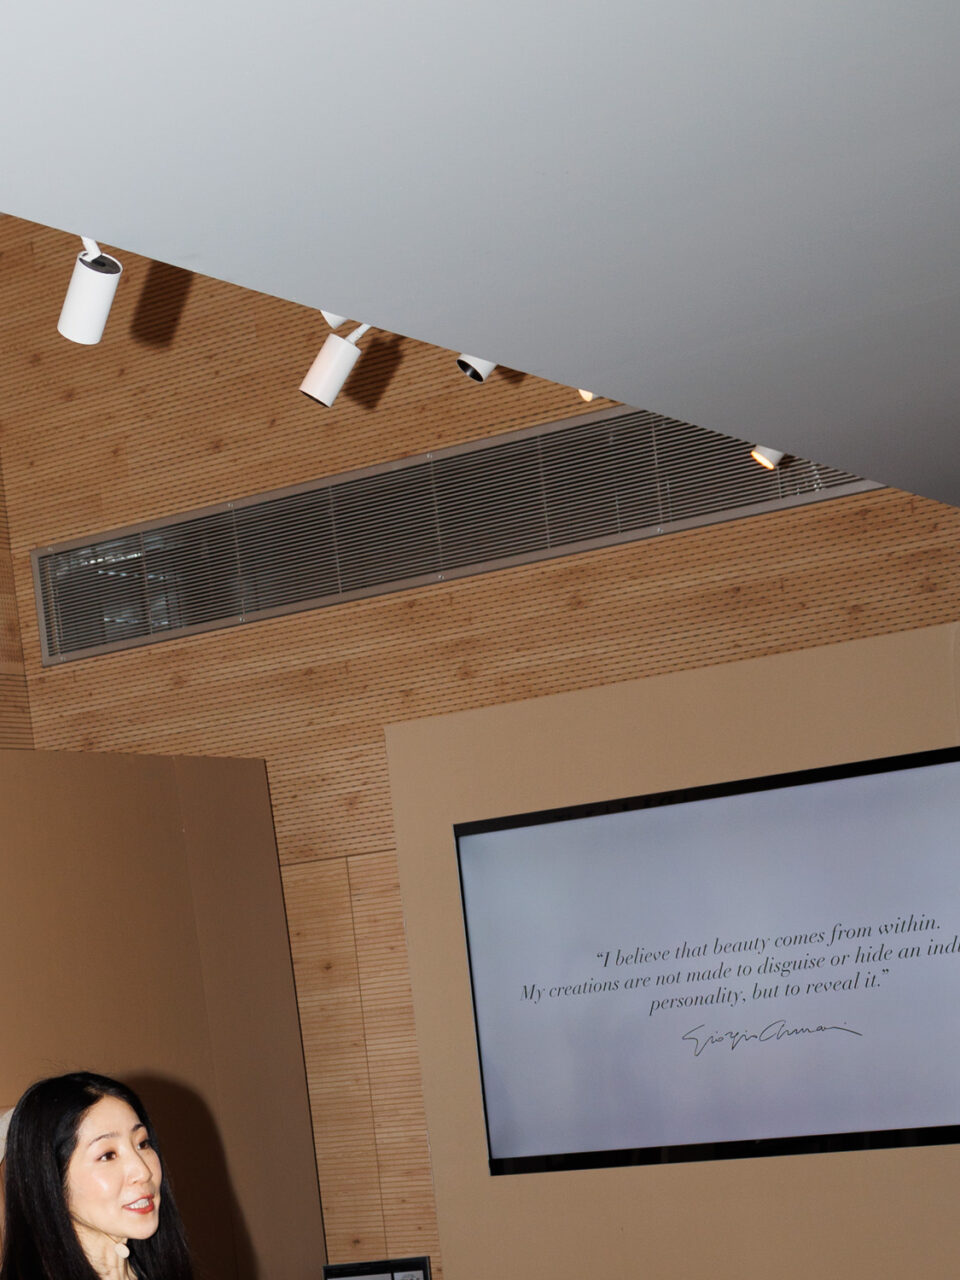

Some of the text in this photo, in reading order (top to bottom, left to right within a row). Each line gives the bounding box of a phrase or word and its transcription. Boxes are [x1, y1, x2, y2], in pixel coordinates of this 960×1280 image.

[615, 947, 670, 967] believe
[675, 941, 708, 960] that
[713, 937, 771, 955] beauty
[774, 930, 825, 948] comes
[826, 923, 872, 947] from
[878, 913, 941, 936] within.
[520, 983, 546, 1005] My
[548, 977, 620, 998] creations
[624, 976, 652, 989] are
[655, 970, 682, 987] not
[686, 961, 732, 983] made
[737, 963, 752, 977] to
[757, 953, 825, 978] disguise
[830, 953, 851, 967] or
[854, 943, 893, 964] hide
[897, 946, 921, 959] an
[648, 985, 747, 1016] personality,
[752, 982, 779, 1000] but
[785, 983, 801, 997] to
[805, 971, 860, 995] reveal
